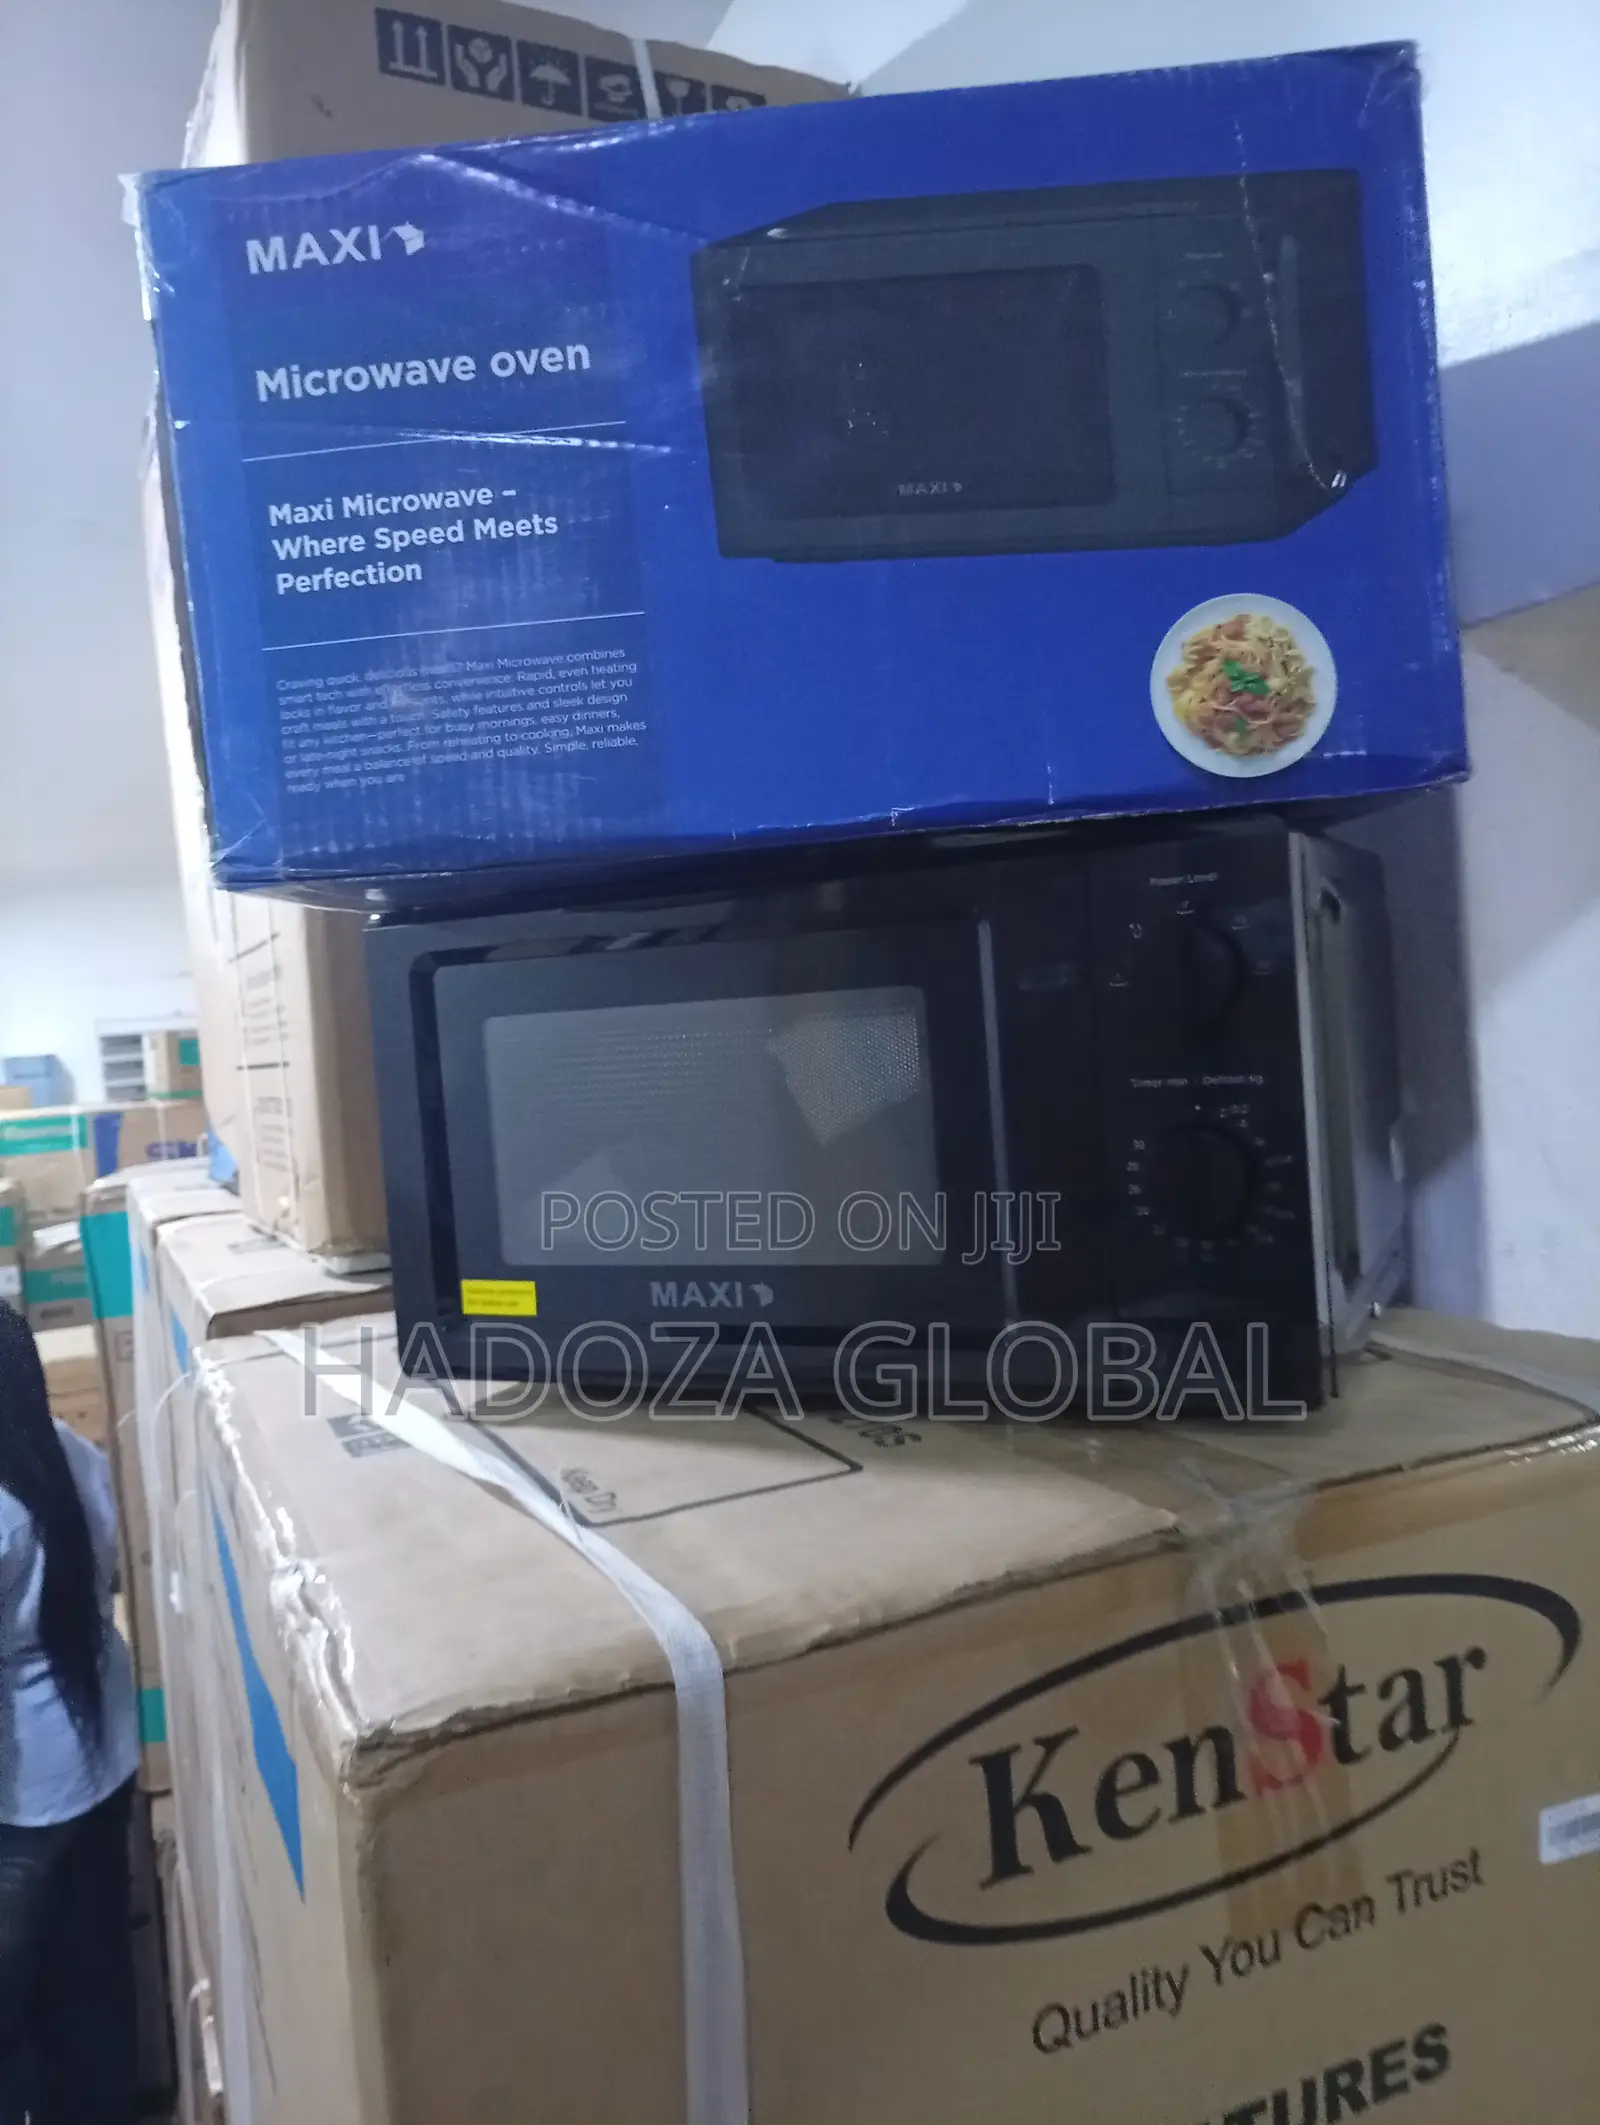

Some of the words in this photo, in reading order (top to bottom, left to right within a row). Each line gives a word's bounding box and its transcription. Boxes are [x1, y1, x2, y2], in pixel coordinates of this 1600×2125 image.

[246, 225, 382, 275] MAXI
[255, 352, 477, 402] Microwave
[490, 343, 592, 378] oven
[898, 481, 948, 496] MAXI
[268, 498, 334, 527] Maxi
[342, 487, 493, 519] Microwave
[272, 533, 366, 561] Where
[374, 519, 465, 552] Speed
[474, 512, 559, 541] Meets
[275, 559, 423, 596] Perfection
[499, 653, 564, 667] Microwave
[566, 648, 625, 661] combines
[559, 668, 588, 677] even
[591, 661, 636, 675] heating
[539, 681, 588, 693] controls
[591, 679, 606, 689] let
[609, 678, 632, 690] you
[476, 701, 524, 714] features
[527, 700, 550, 710] and
[553, 696, 583, 707] sleek
[587, 692, 627, 705] design
[541, 714, 569, 725] easy
[572, 707, 619, 721] dinners,
[506, 733, 518, 741] to
[576, 724, 604, 735] Maxi
[606, 719, 645, 731] makes
[472, 750, 495, 760] and
[650, 1281, 743, 1309] MAXI
[969, 1645, 1488, 1891] KenStar
[1031, 1963, 1190, 2055] Quality
[1200, 1925, 1282, 1987] You
[1293, 1892, 1376, 1952] Can
[1385, 1848, 1488, 1916] Trust
